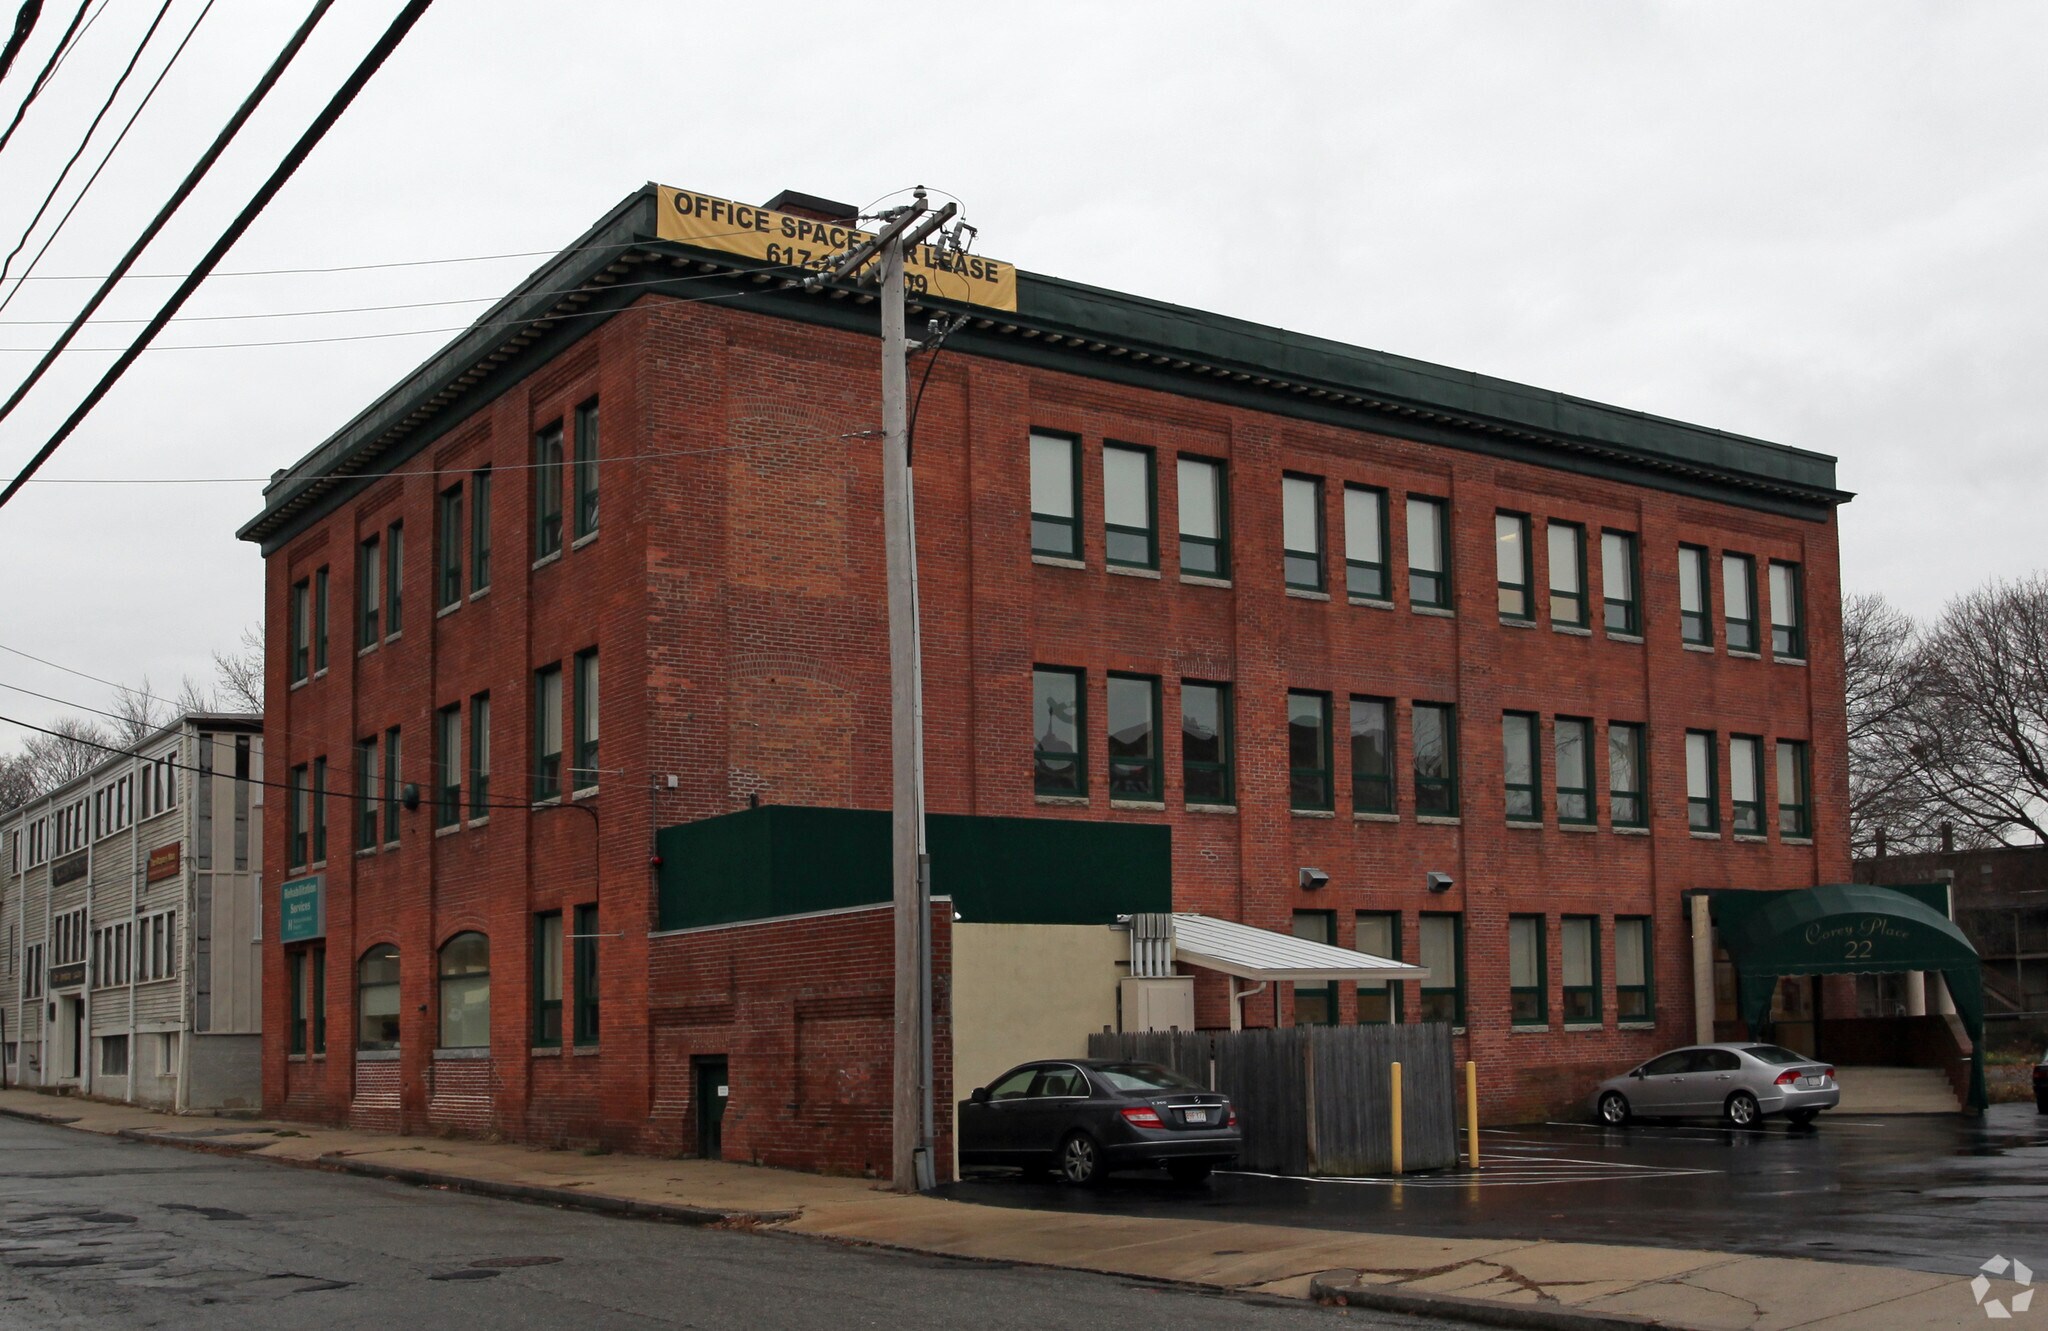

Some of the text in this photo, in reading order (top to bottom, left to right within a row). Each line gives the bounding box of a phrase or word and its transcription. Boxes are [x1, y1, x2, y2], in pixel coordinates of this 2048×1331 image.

[674, 192, 770, 234] OFFICE
[781, 216, 862, 249] SPACE
[290, 902, 311, 914] Services
[1805, 918, 1910, 944] Corey Place
[1844, 940, 1872, 959] 22
